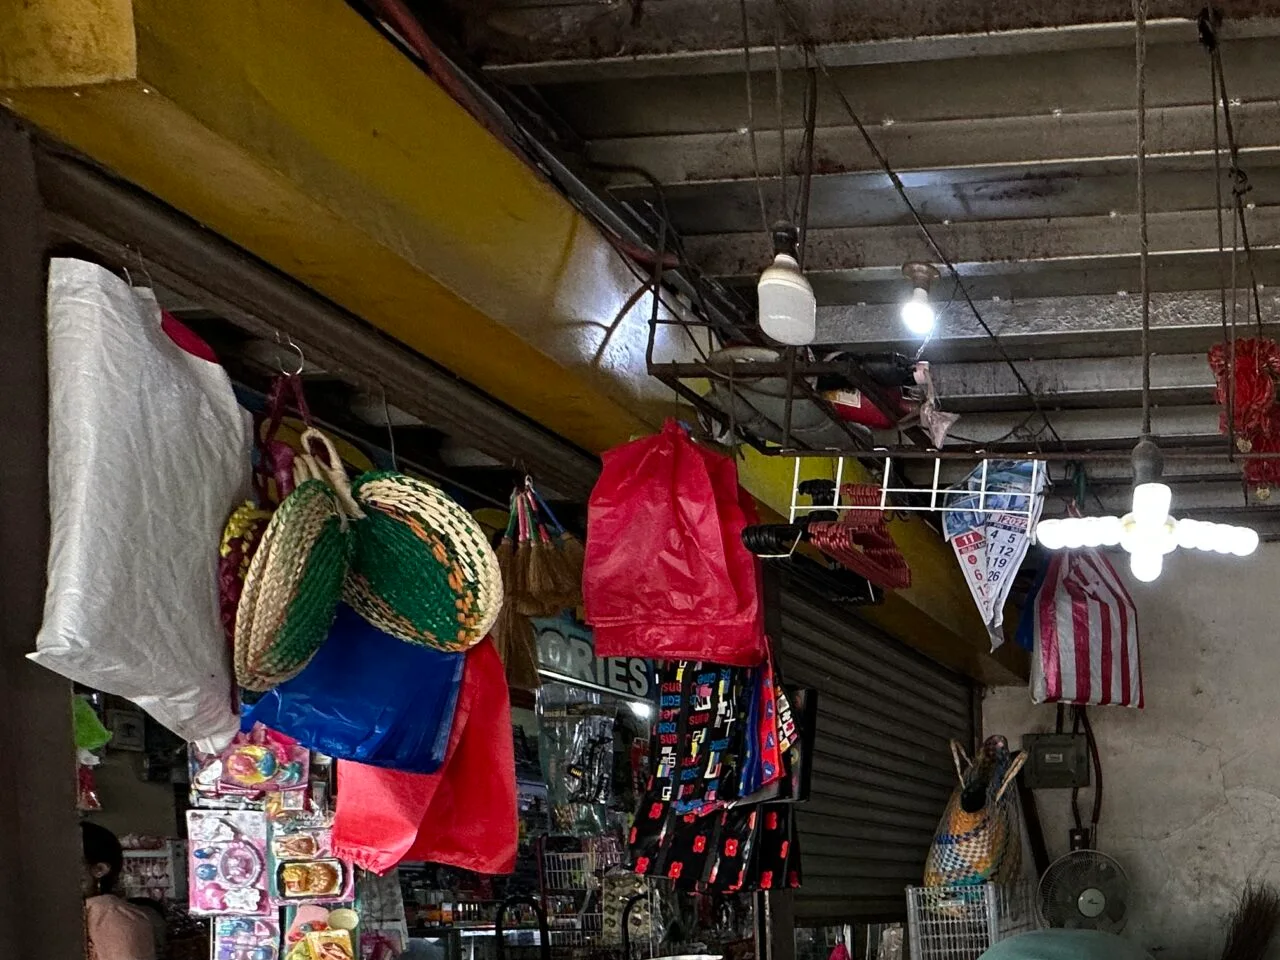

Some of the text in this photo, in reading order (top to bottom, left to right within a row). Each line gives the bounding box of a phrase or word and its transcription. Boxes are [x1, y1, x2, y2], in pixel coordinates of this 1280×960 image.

[1002, 514, 1028, 527] 2022
[962, 535, 975, 545] 11
[990, 530, 1016, 543] 4 5
[999, 544, 1014, 556] 12
[993, 558, 1007, 568] 19
[974, 569, 1000, 582] 6 26
